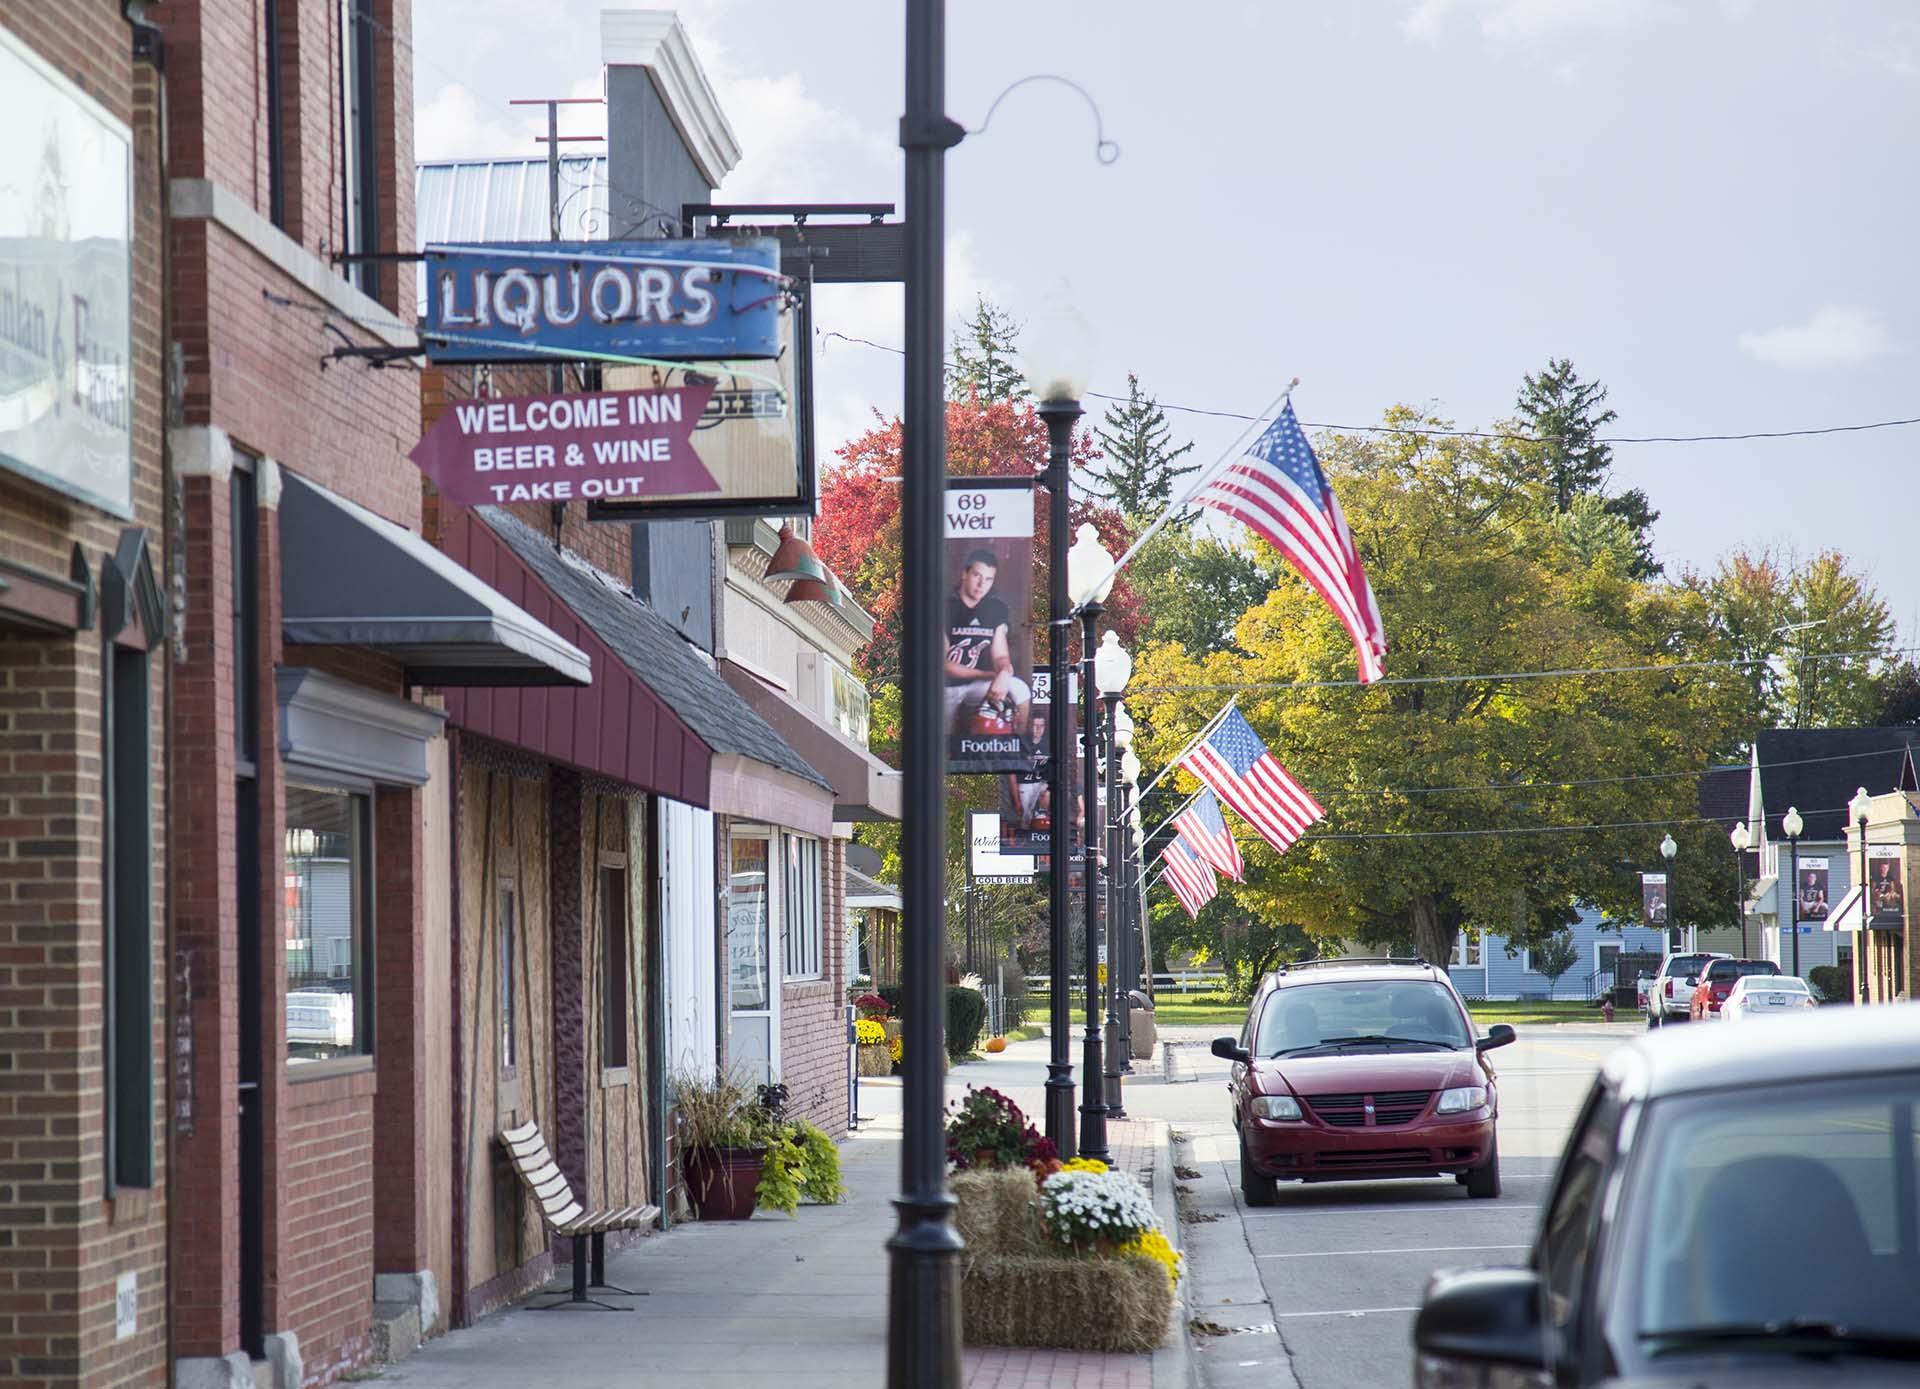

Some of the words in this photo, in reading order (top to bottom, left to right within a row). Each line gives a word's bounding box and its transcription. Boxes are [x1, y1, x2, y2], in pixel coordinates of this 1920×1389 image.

[441, 267, 712, 333] LIQUORS
[456, 397, 620, 434] WELCOME
[628, 393, 682, 425] INN
[474, 445, 555, 472] BEER
[564, 443, 585, 467] &
[592, 438, 672, 464] WINE
[490, 481, 573, 502] TAKE
[580, 476, 645, 497] OUT
[958, 494, 986, 510] 69
[947, 513, 995, 530] Weir
[961, 738, 1020, 753] Football
[978, 876, 1002, 884] COLD
[1005, 876, 1030, 884] BEER
